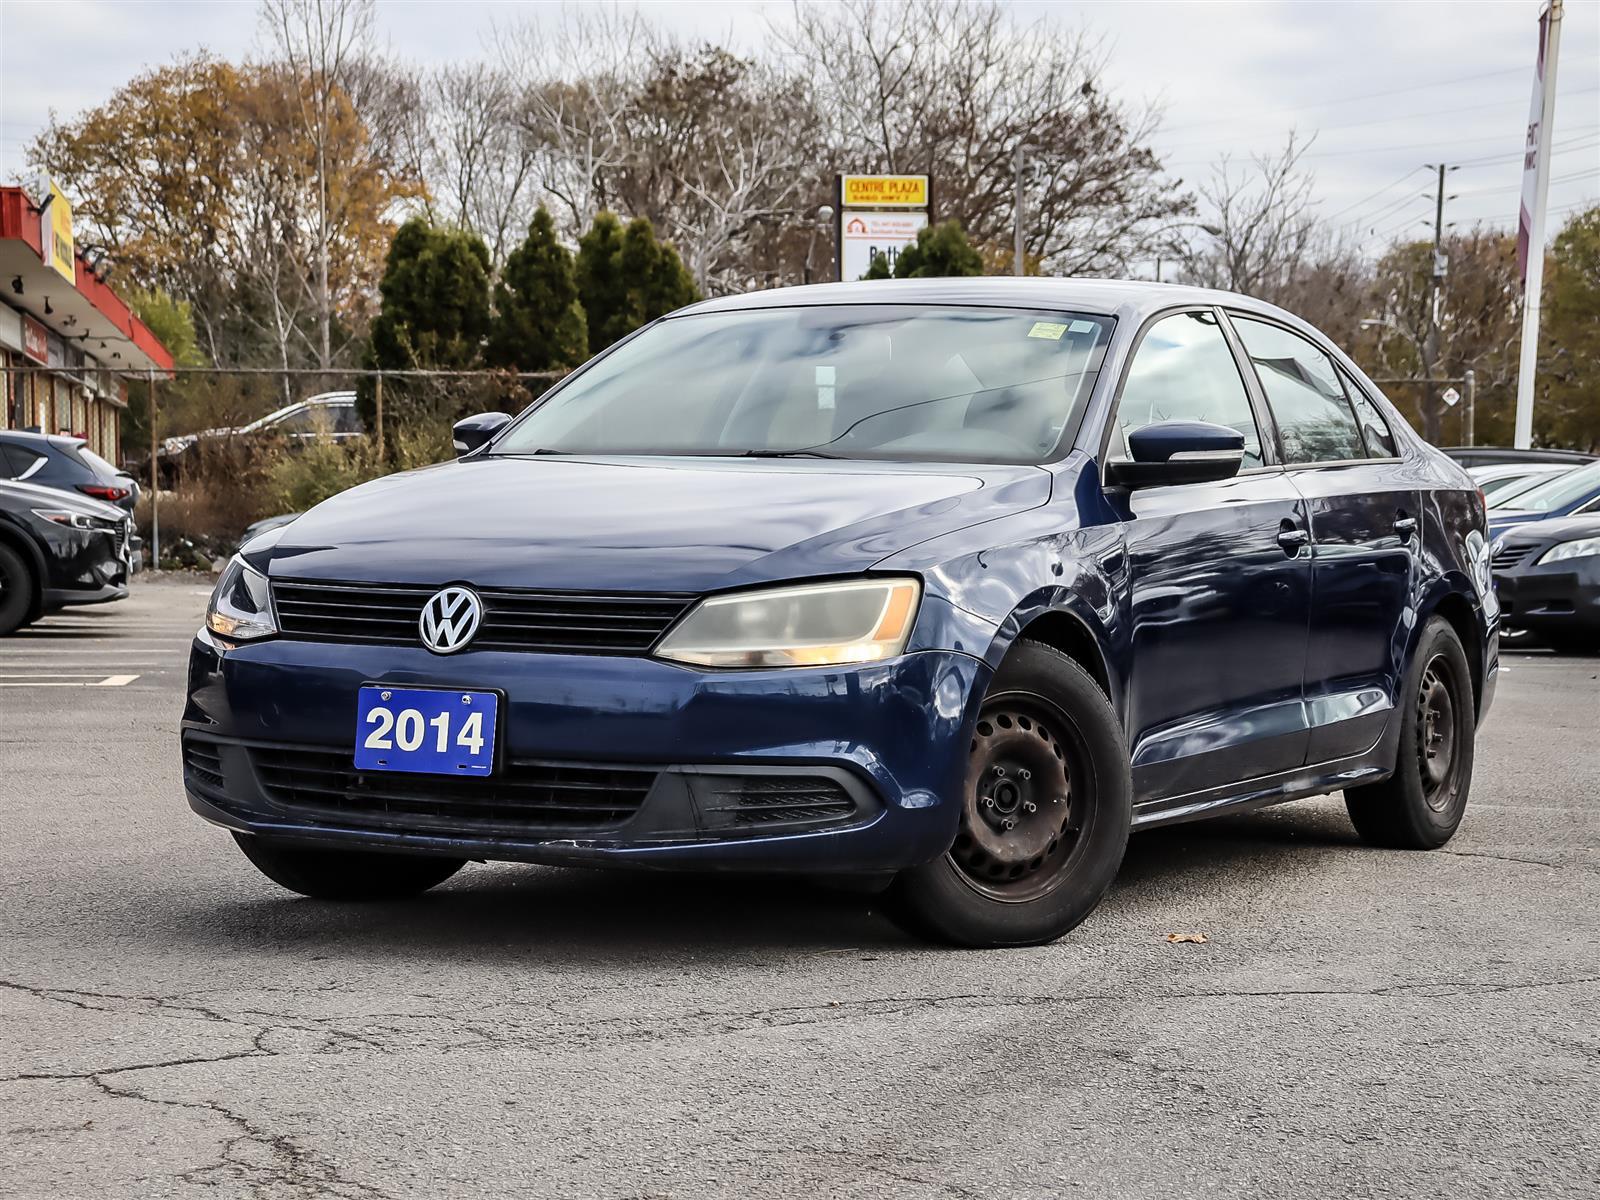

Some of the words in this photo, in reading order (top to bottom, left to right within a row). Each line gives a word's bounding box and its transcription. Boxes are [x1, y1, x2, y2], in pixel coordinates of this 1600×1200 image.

[850, 181, 884, 193] CENTRE
[889, 181, 920, 193] PLAZA
[421, 588, 481, 652] VW
[364, 707, 485, 755] 2014
